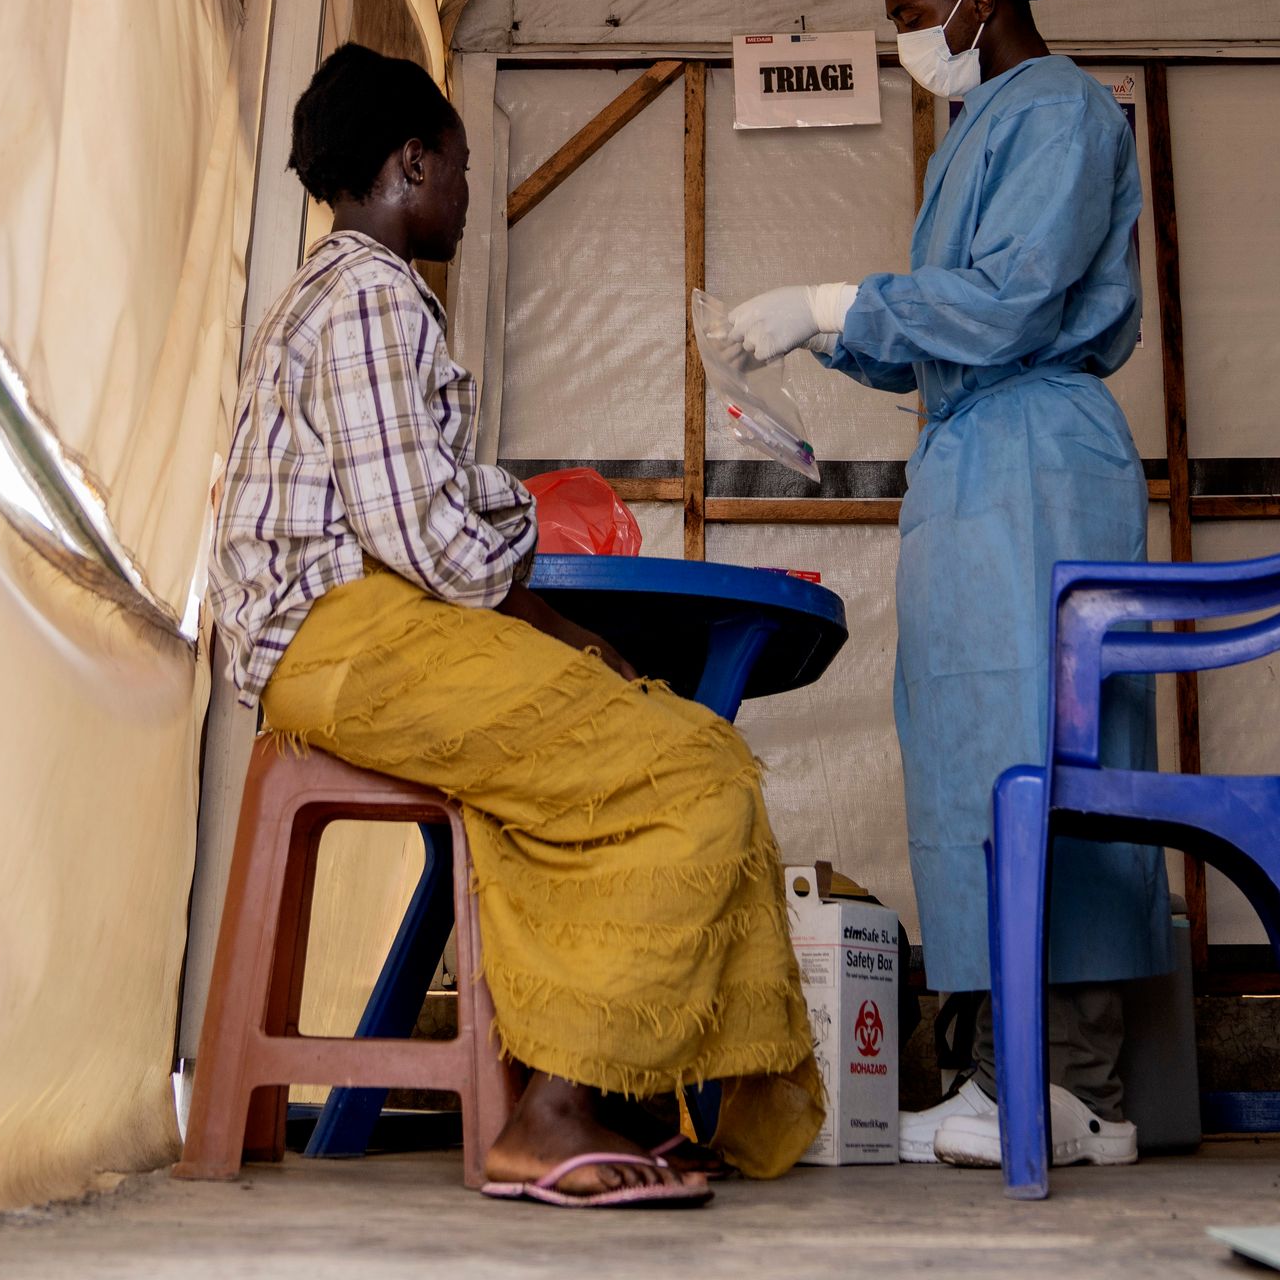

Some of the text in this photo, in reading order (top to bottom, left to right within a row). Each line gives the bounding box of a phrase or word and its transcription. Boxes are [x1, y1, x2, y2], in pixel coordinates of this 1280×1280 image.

[759, 63, 854, 94] TRIAGE
[844, 926, 879, 943] timSafe
[881, 930, 891, 945] 5L
[846, 950, 875, 973] Safety
[877, 954, 893, 971] Box
[850, 1062, 888, 1075] BIOHAZARD
